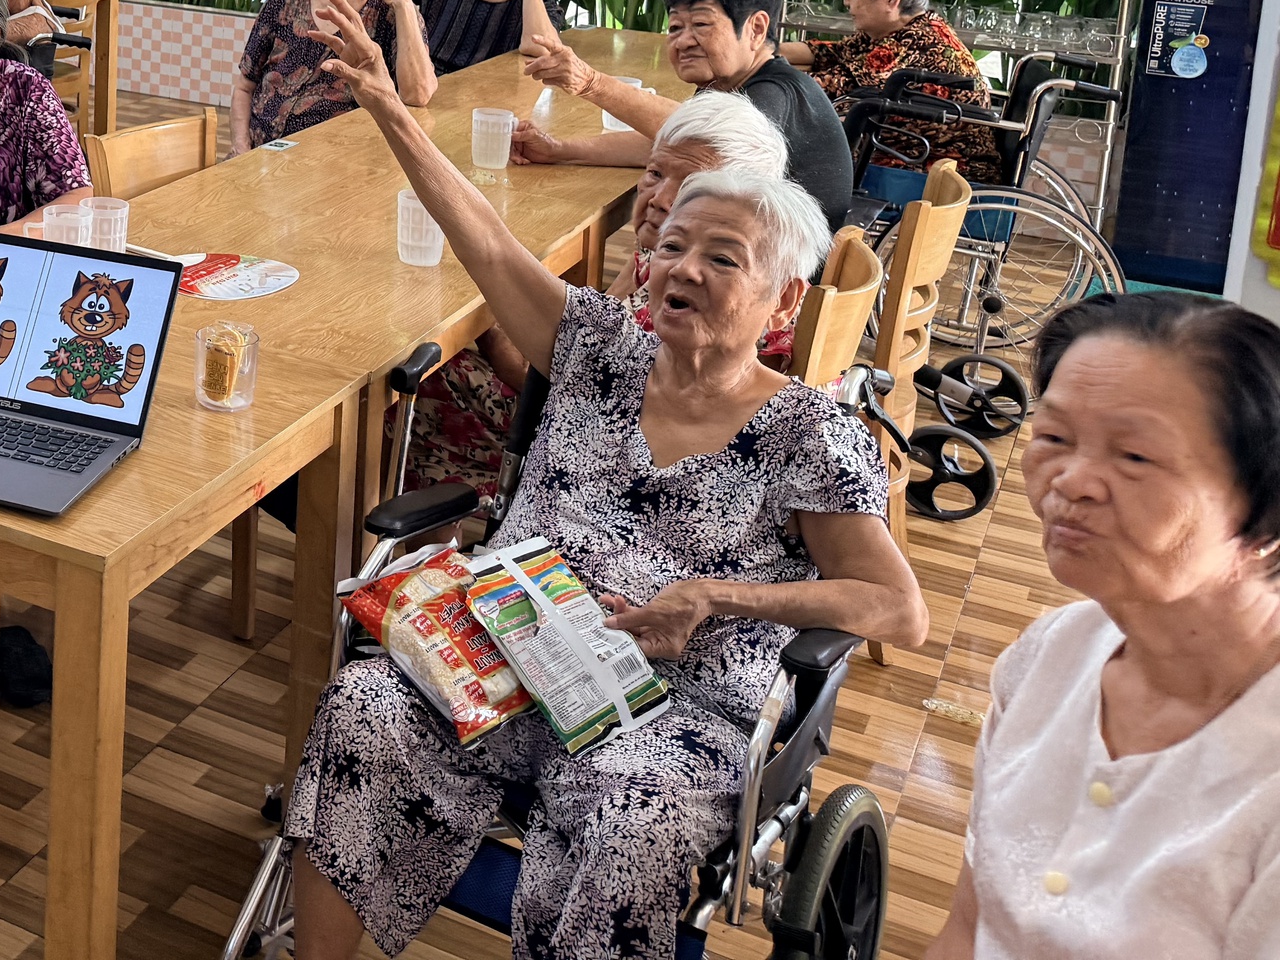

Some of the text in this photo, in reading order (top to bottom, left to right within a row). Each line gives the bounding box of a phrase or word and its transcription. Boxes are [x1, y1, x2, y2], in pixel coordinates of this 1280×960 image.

[1151, 5, 1168, 57] UltraPURE
[439, 600, 465, 622] TUYẾT
[466, 631, 491, 652] ANT
